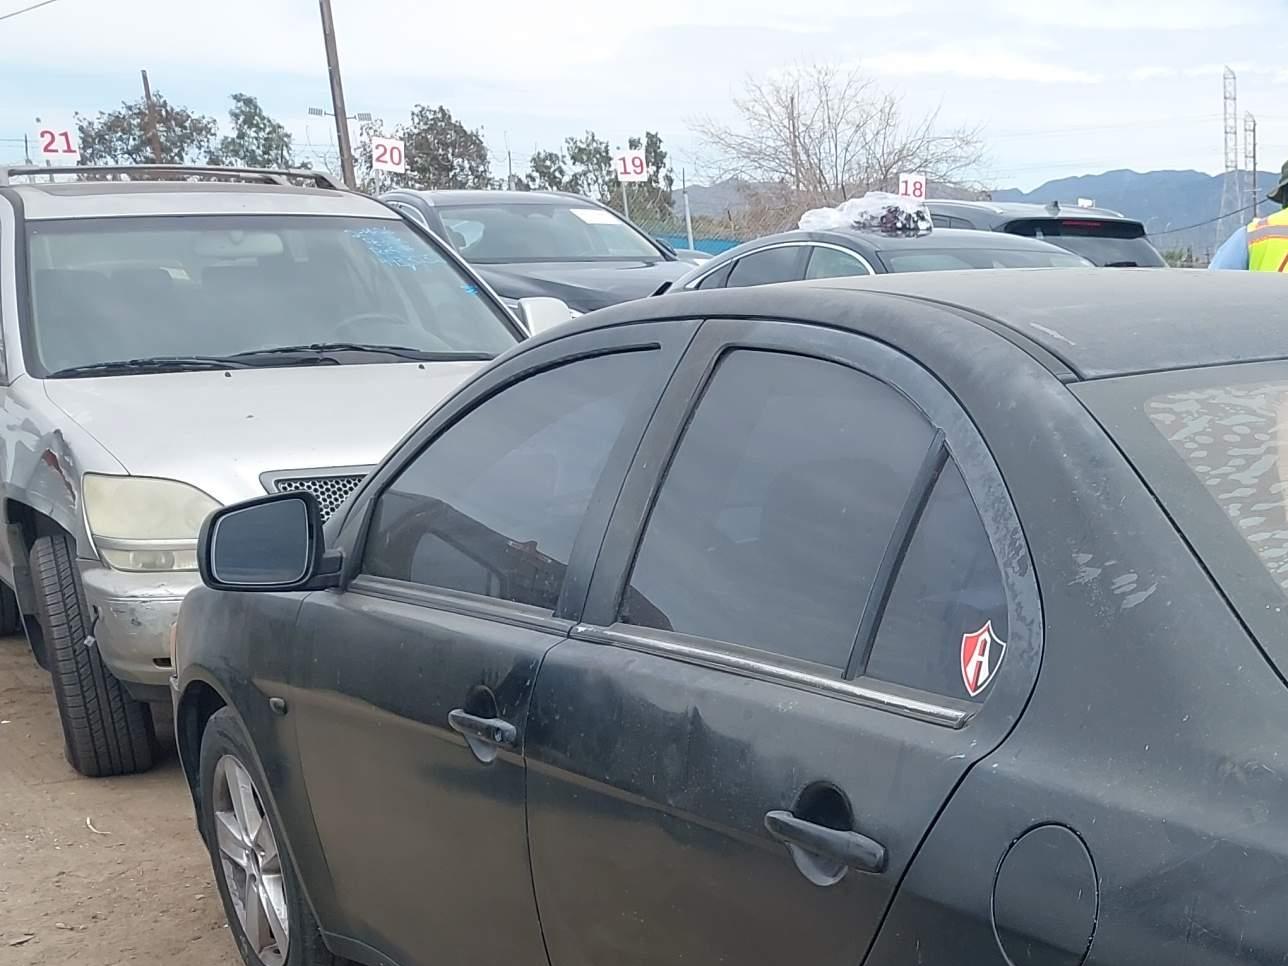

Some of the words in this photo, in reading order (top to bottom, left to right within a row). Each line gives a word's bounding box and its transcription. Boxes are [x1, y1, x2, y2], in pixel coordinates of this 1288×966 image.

[40, 131, 77, 154] 21
[375, 145, 402, 167] 20
[619, 156, 645, 175] 19
[901, 180, 924, 197] 18
